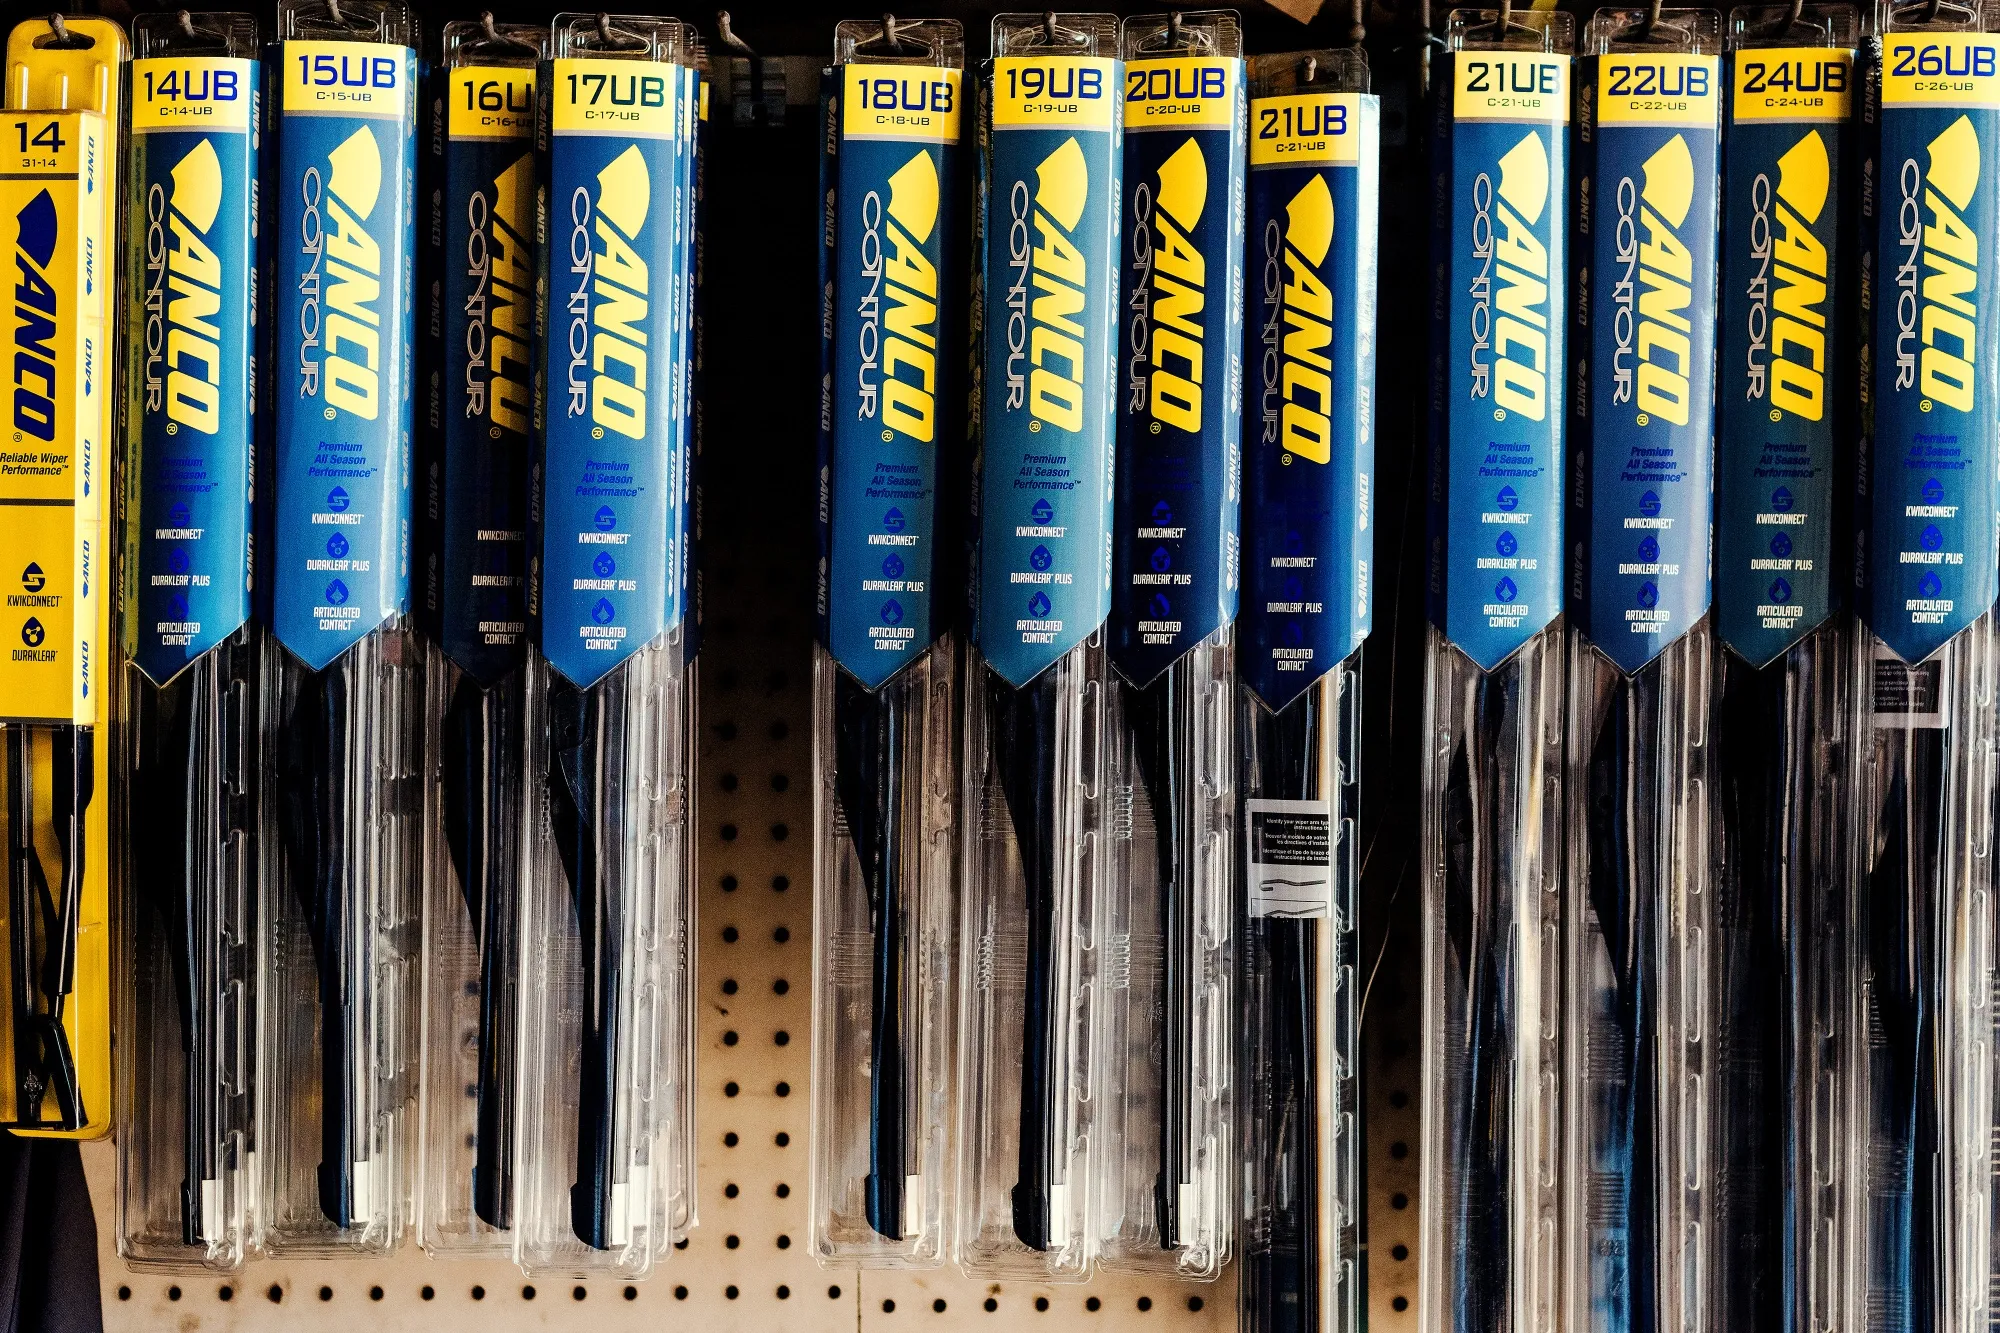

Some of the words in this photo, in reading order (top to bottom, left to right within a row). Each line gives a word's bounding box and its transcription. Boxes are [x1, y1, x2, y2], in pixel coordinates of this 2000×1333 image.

[1892, 45, 1995, 77] 26UB
[299, 55, 396, 88] 15UB
[1467, 63, 1560, 94] 21UB
[1608, 66, 1708, 96] 22UB
[1743, 62, 1846, 93] 24UB
[144, 70, 238, 102] 14UB
[1007, 68, 1102, 99] 19UB
[1127, 68, 1225, 102] 20UB
[1915, 82, 1973, 91] C-26-UB
[568, 74, 664, 107] 17UB
[859, 78, 953, 113] 18UB
[316, 91, 371, 102] C-15-UB
[464, 81, 532, 112] 16U
[1766, 98, 1823, 106] C-24-UB
[1487, 98, 1541, 107] C-21-UB
[1630, 101, 1686, 111] C-22-UB
[160, 106, 213, 116] C-14-UB
[1024, 104, 1077, 113] C-19-UB
[1146, 105, 1200, 114] C-20-UB
[585, 110, 640, 121] C-17-UB
[876, 115, 929, 125] C-18-UB
[1259, 105, 1347, 139] 21UB
[15, 122, 65, 152] 14
[1276, 142, 1325, 152] C-21-UB
[22, 159, 56, 168] 31-14
[1895, 158, 1921, 391] CONTOUR
[299, 166, 323, 398] CONTOUR
[1469, 172, 1494, 399] CONTOUR
[1747, 173, 1771, 401] CONTOUR
[1006, 180, 1030, 411] CONTOUR
[1612, 177, 1637, 404] CONTOUR
[145, 183, 166, 414] CONTOUR
[567, 186, 592, 417] CONTOUR
[1130, 182, 1151, 413] CONTOUR
[465, 191, 489, 417] CONTOUR
[858, 190, 882, 420] CONTOUR
[1262, 219, 1281, 445] CONTOUR
[318, 442, 362, 451] Premium
[1488, 442, 1530, 452] Premium
[1631, 447, 1673, 457] Premium
[1763, 442, 1806, 453] Premium
[0, 453, 37, 463] Reliable
[40, 453, 68, 464] Wiper
[314, 455, 327, 464] All
[330, 456, 366, 464] Season
[1023, 454, 1066, 464] Premium
[1484, 455, 1497, 464] All
[1499, 455, 1533, 465] Season
[1760, 455, 1772, 465] All
[1775, 456, 1810, 465] Season
[585, 460, 629, 471] Premium
[1627, 460, 1640, 469] All
[1642, 460, 1676, 470] Season
[1019, 467, 1032, 477] All
[1034, 467, 1069, 477] Season
[582, 474, 594, 483] All
[597, 474, 633, 484] Season
[1360, 473, 1368, 513] ANCO
[1906, 506, 1956, 518] KWIKCONNECT
[312, 513, 362, 524] KWIKCONNECT
[1482, 513, 1530, 524] KWIKCONNECT
[1624, 518, 1672, 529] KWIKCONNECT
[1756, 514, 1805, 525] KWIKCONNECT
[156, 529, 203, 539] KWIKCONNECT
[1016, 527, 1065, 538] KWIKCONNECT
[1138, 528, 1184, 539] KWIKCONNECT
[579, 533, 628, 544] KWIKCONNECT
[868, 535, 917, 546] KWIKCONNECT
[1271, 558, 1315, 568] KWIKCONNECT
[1477, 559, 1518, 569] DURAKLEAR
[1521, 559, 1536, 569] PLUS
[1900, 552, 1943, 564] DURAKLEAR
[1946, 553, 1963, 565] PLUS
[307, 560, 348, 571] DURAKLEAR
[352, 560, 369, 571] PLUS
[1619, 564, 1660, 575] DURAKLEAR
[1663, 565, 1679, 575] PLUS
[1751, 559, 1792, 570] DURAKLEAR
[1795, 560, 1812, 570] PLUS
[152, 575, 189, 586] DURAKLEAR
[192, 576, 210, 586] PLUS
[1011, 573, 1051, 584] DURAKLEAR
[1055, 573, 1072, 584] PLUS
[1133, 575, 1171, 585] DURAKLEAR
[1174, 575, 1191, 585] PLUS
[574, 579, 615, 590] DURAKLEAR
[618, 580, 636, 591] PLUS
[863, 580, 904, 591] DURAKLEAR
[907, 581, 923, 591] PLUS
[7, 595, 60, 607] KWIKCONNECT
[1906, 600, 1953, 612] ARTICULATED
[314, 607, 360, 618] ARTICULATED
[1267, 603, 1303, 613] DURAKLEAR
[1305, 603, 1322, 613] PLUS
[1484, 605, 1528, 616] ARTICULATED
[1757, 606, 1803, 617] ARTICULATED
[1626, 610, 1669, 621] ARTICULATED
[1912, 612, 1945, 624] CONTACT
[157, 623, 200, 633] ARTICULATED
[320, 619, 351, 630] CONTACT
[479, 622, 524, 633] ARTICULATED
[1017, 620, 1062, 631] ARTICULATED
[1138, 621, 1181, 633] ARTICULATED
[1489, 617, 1521, 628] CONTACT
[1631, 622, 1662, 633] CONTACT
[1763, 618, 1795, 629] CONTACT
[580, 627, 626, 638] ARTICULATED
[869, 627, 914, 638] ARTICULATED
[1022, 632, 1055, 643] CONTACT
[162, 635, 193, 645] CONTACT
[485, 634, 516, 644] CONTACT
[586, 639, 618, 650] CONTACT
[1143, 634, 1174, 644] CONTACT
[875, 640, 906, 650] CONTACT
[12, 650, 56, 662] DURAKLEAR
[1273, 649, 1313, 659] ARTICULATED
[1277, 661, 1306, 671] CONTACT
